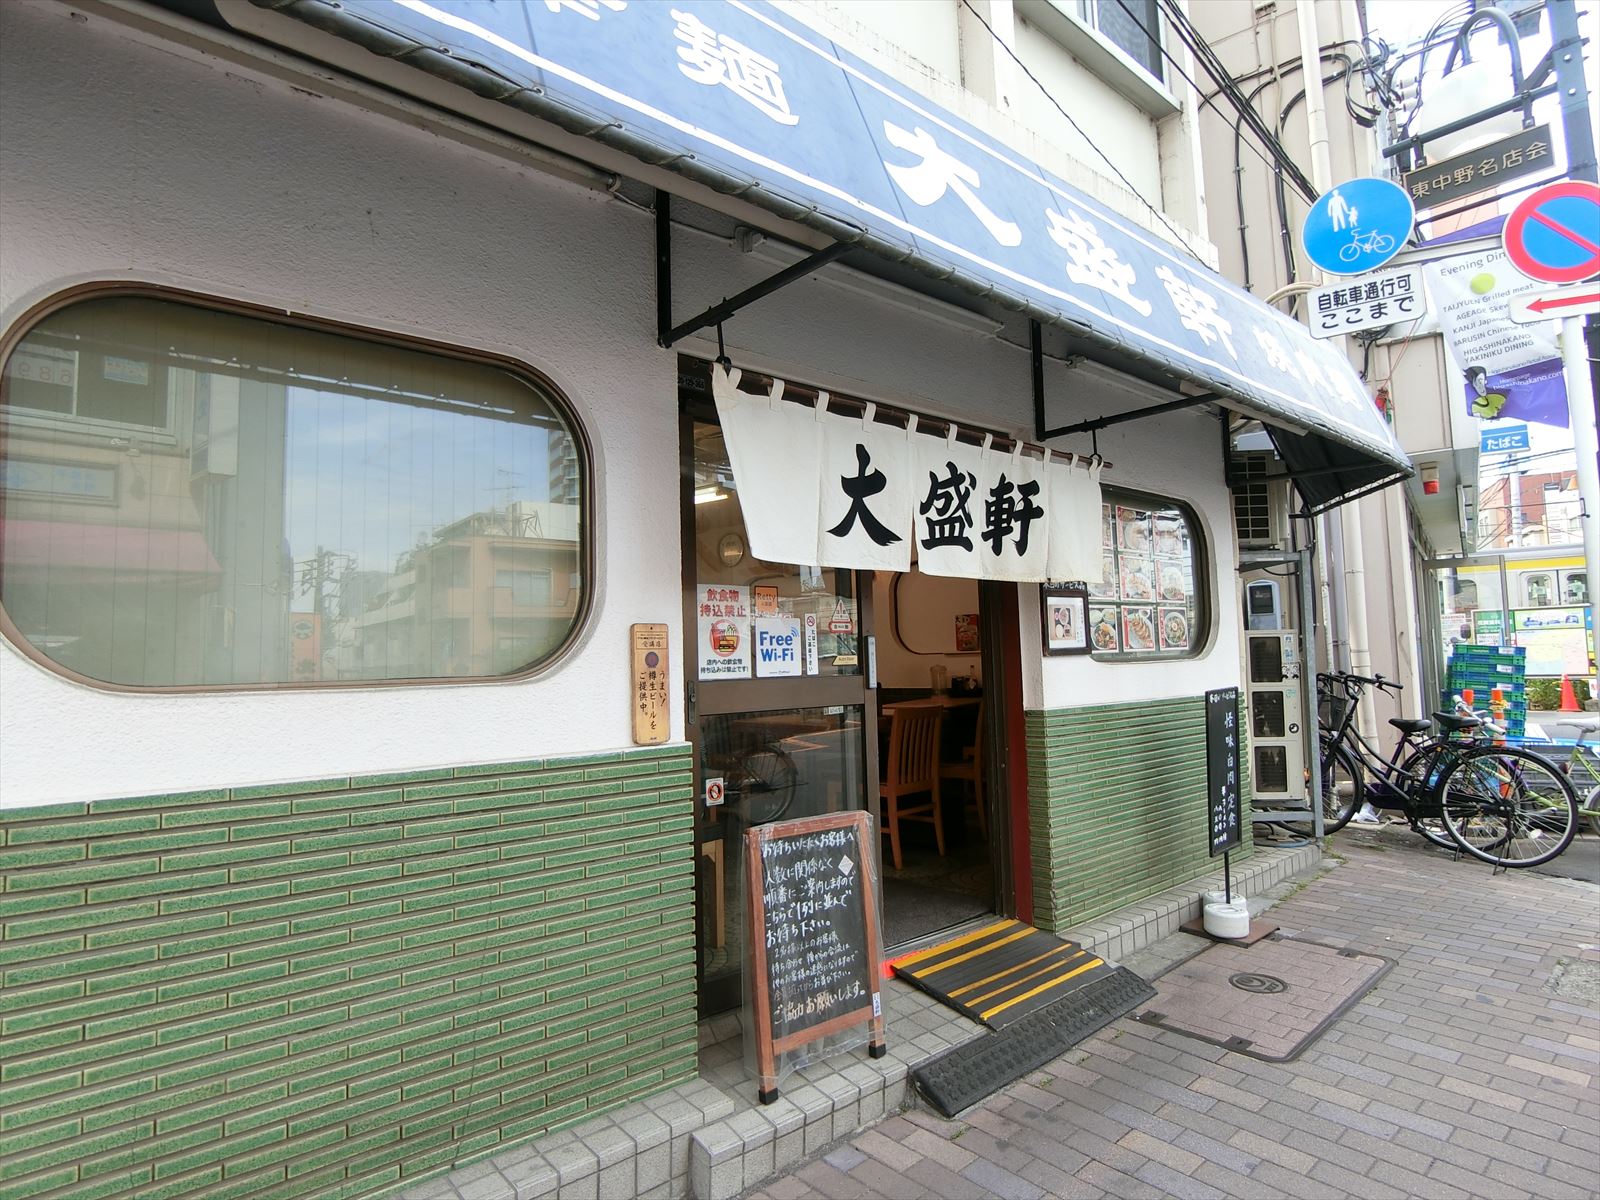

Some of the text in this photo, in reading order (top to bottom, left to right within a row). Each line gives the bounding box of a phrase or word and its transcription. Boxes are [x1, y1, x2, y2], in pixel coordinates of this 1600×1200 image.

[1410, 140, 1548, 200] 東中野名店会
[882, 120, 1238, 361] 大盛軒
[1440, 258, 1484, 276] Evening
[1317, 274, 1413, 311] 自転車通行可
[1482, 289, 1511, 303] Grilled
[1512, 283, 1534, 295] meat
[1321, 297, 1415, 330] ここまで
[1452, 323, 1476, 335] KANJI
[1463, 333, 1531, 356] HIGASHINAKANO
[1504, 340, 1534, 353] DINING
[1486, 435, 1523, 450] たばこ
[826, 443, 1044, 557] 大盛軒
[706, 588, 740, 601] 飲食物
[757, 592, 775, 603] Retty
[700, 604, 747, 617] 持込禁止
[759, 631, 793, 646] Free
[761, 649, 794, 662] Wi-Fi
[648, 670, 657, 730] 樽生ビールを
[765, 857, 834, 888] 人数に関係なく
